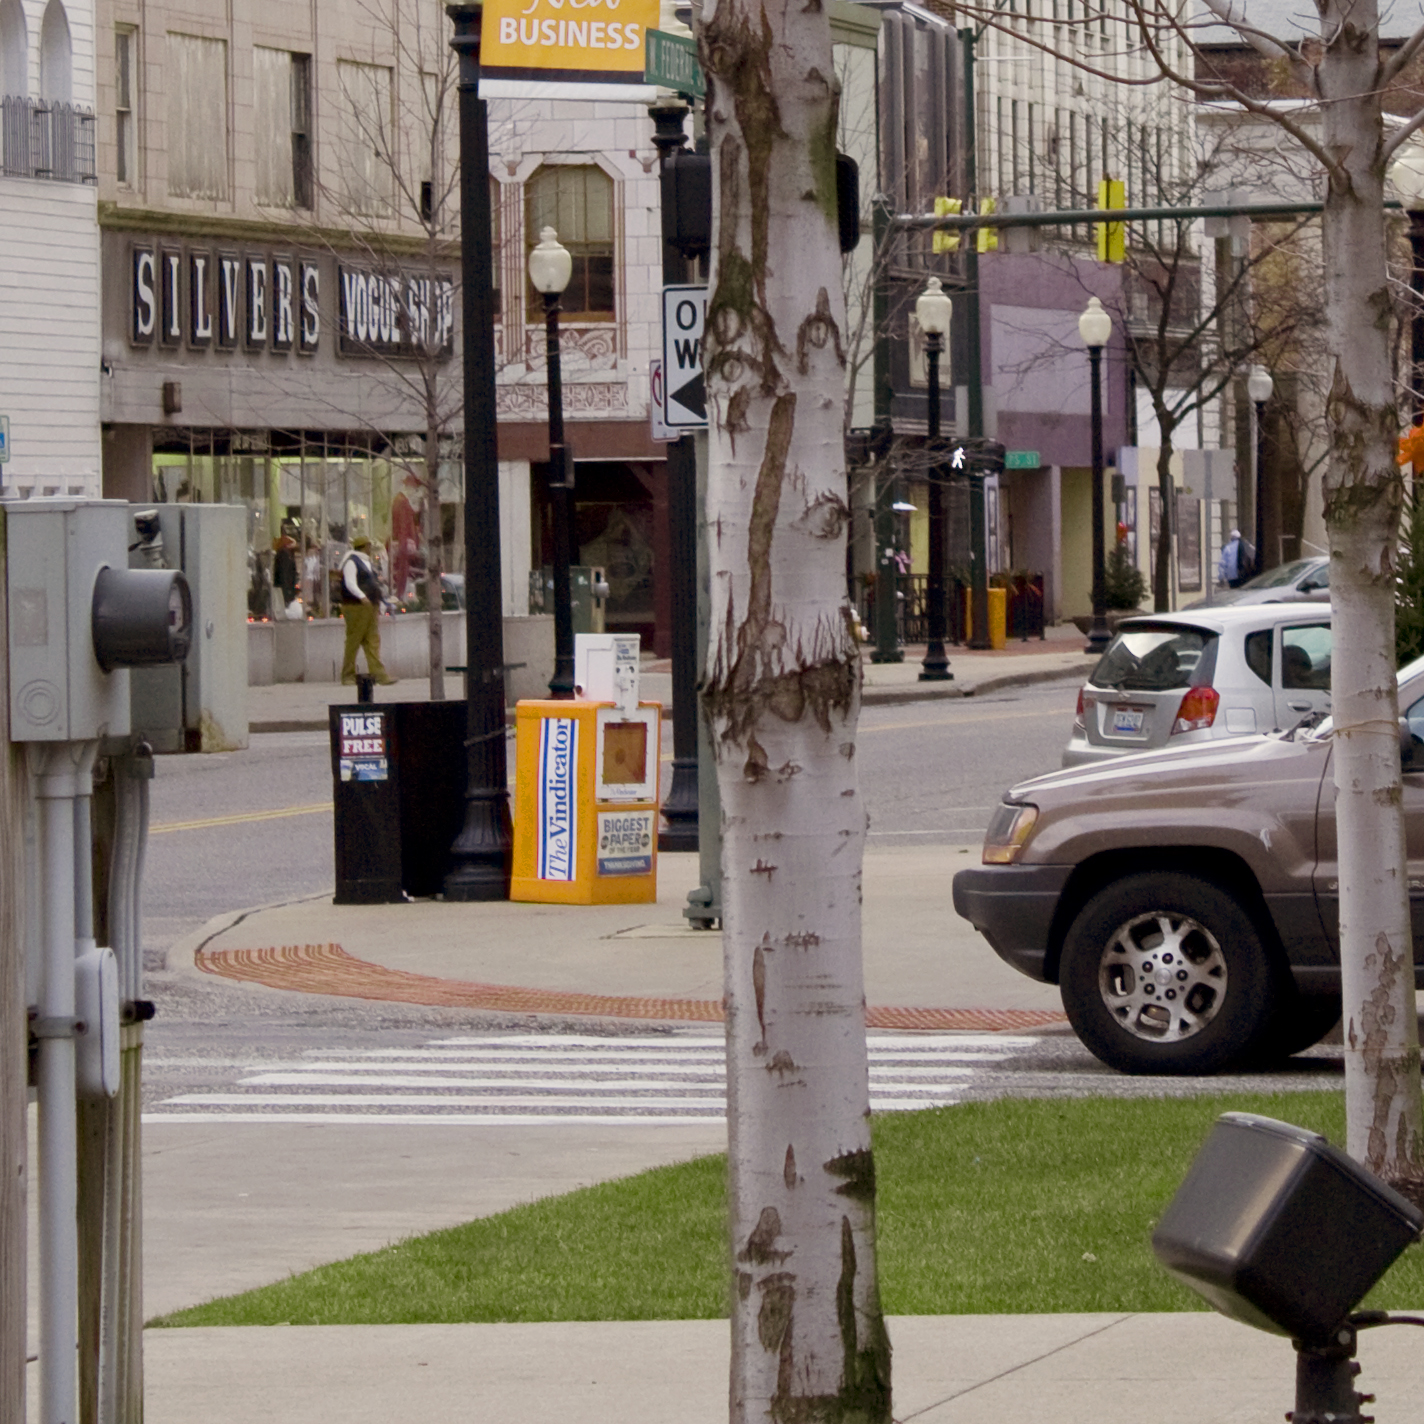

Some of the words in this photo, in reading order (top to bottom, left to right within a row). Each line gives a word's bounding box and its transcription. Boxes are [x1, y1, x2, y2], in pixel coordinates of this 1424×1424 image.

[500, 17, 640, 50] BUSINESS
[137, 252, 319, 344] SILVERS
[342, 717, 382, 736] PULSE
[343, 739, 383, 753] FREE
[549, 719, 569, 839] Vindicator
[604, 817, 650, 833] BIGGEST
[609, 832, 642, 847] PAPER
[549, 838, 568, 877] The
